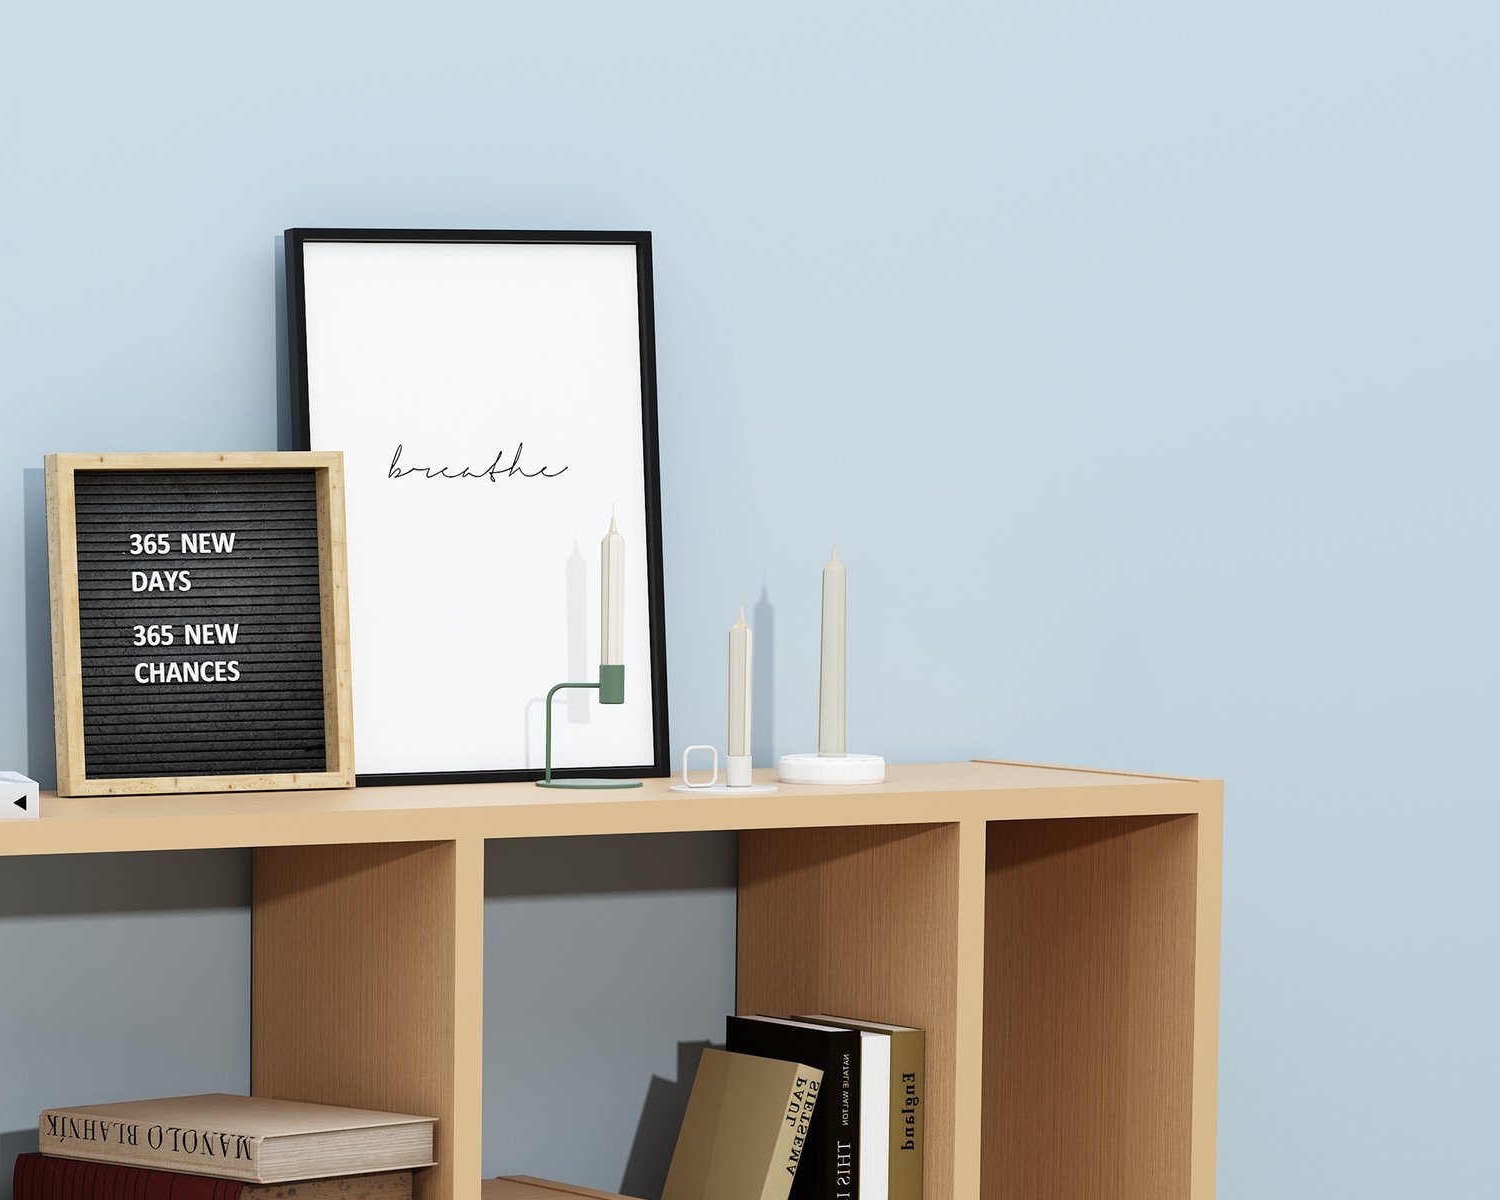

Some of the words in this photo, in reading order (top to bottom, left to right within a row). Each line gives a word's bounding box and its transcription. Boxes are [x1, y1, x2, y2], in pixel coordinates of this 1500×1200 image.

[387, 441, 569, 483] breathe
[129, 532, 171, 555] 365
[180, 532, 236, 556] NEW
[131, 570, 192, 592] DAYS
[133, 624, 174, 647] 365
[184, 623, 239, 645] NEW
[134, 660, 241, 684] CHANCES
[46, 1114, 138, 1146] BLAHNÍK
[147, 1124, 256, 1161] MANOLO
